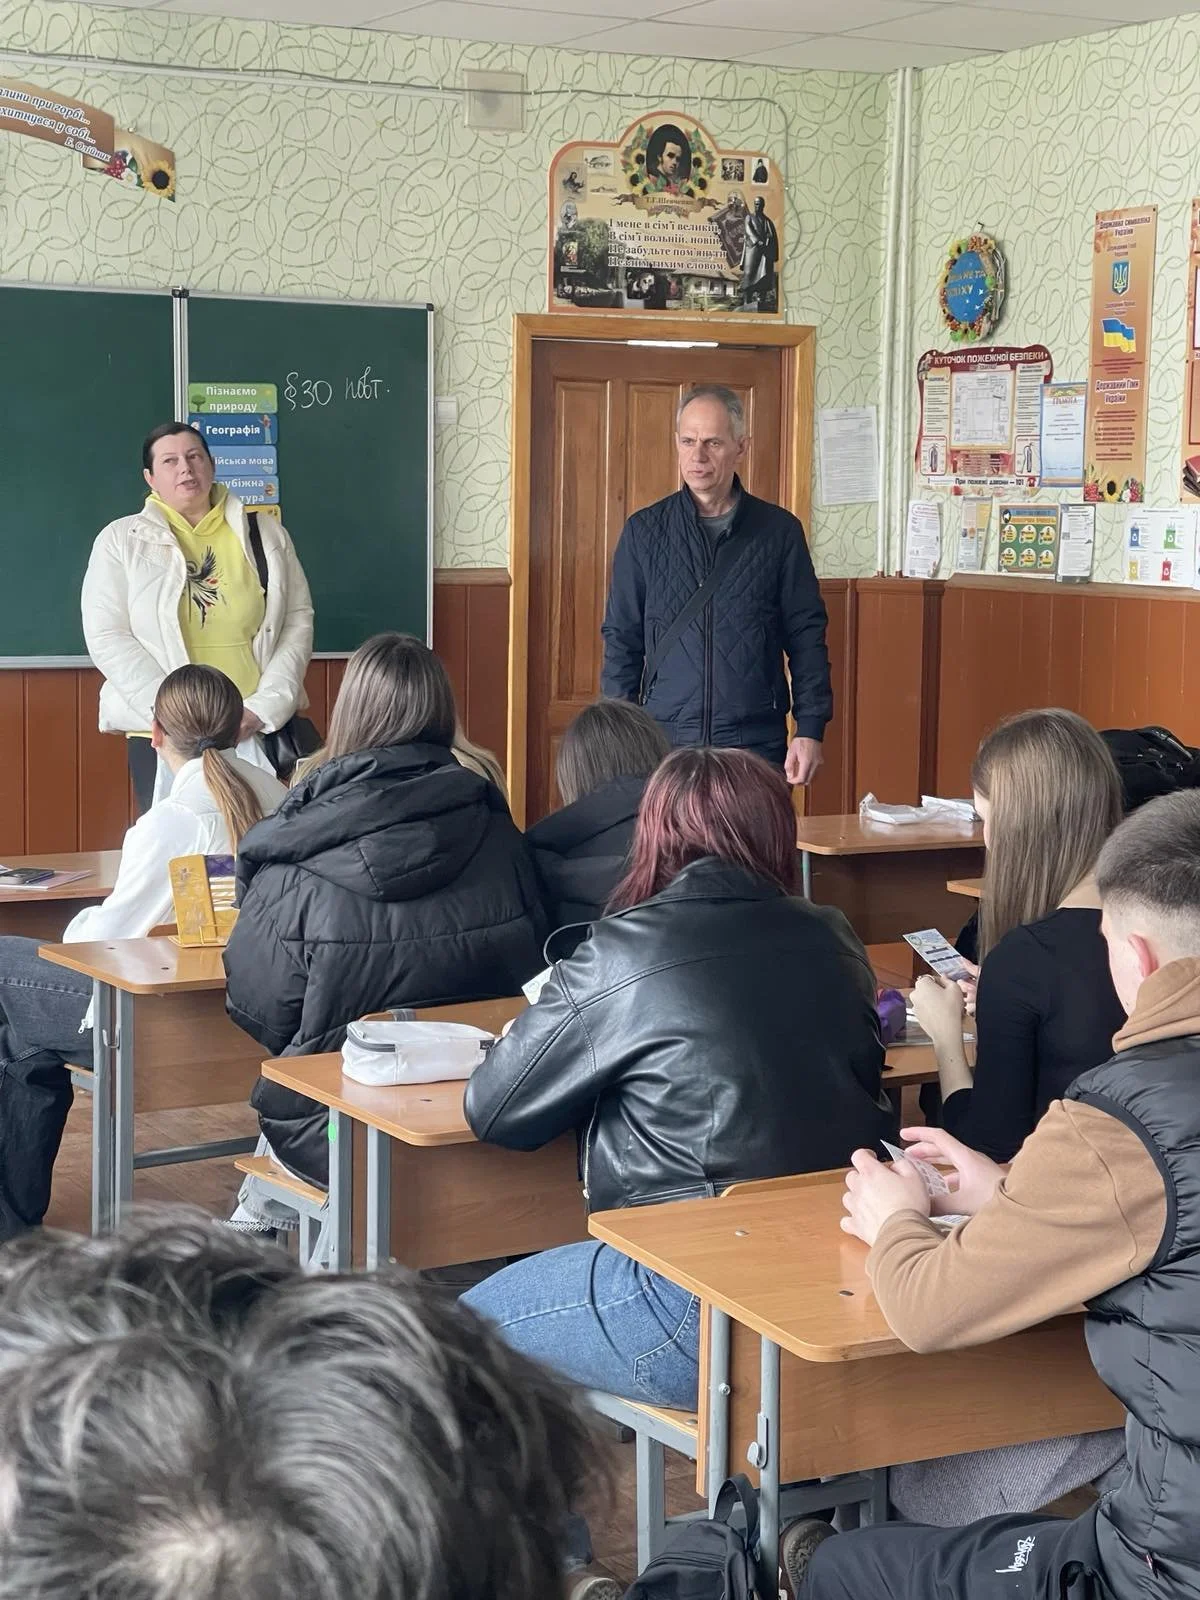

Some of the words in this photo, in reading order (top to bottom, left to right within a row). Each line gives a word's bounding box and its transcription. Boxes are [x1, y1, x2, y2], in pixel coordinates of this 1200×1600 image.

[0, 107, 55, 127] хитнувся
[56, 122, 65, 133] у
[609, 231, 616, 240] В
[625, 245, 670, 257] забудьте
[686, 262, 726, 270] словом.
[934, 354, 966, 365] КУТОЧОК
[967, 352, 1009, 363] ПОЖЕЖНОЇ
[1010, 351, 1045, 361] БЕЗПЕКИ
[206, 386, 257, 396] Пізнаємо
[284, 371, 332, 411] §30
[209, 403, 257, 413] природу
[206, 425, 260, 436] Географія
[215, 456, 247, 465] ійська
[217, 478, 264, 489] убіжна
[240, 494, 264, 505] тура
